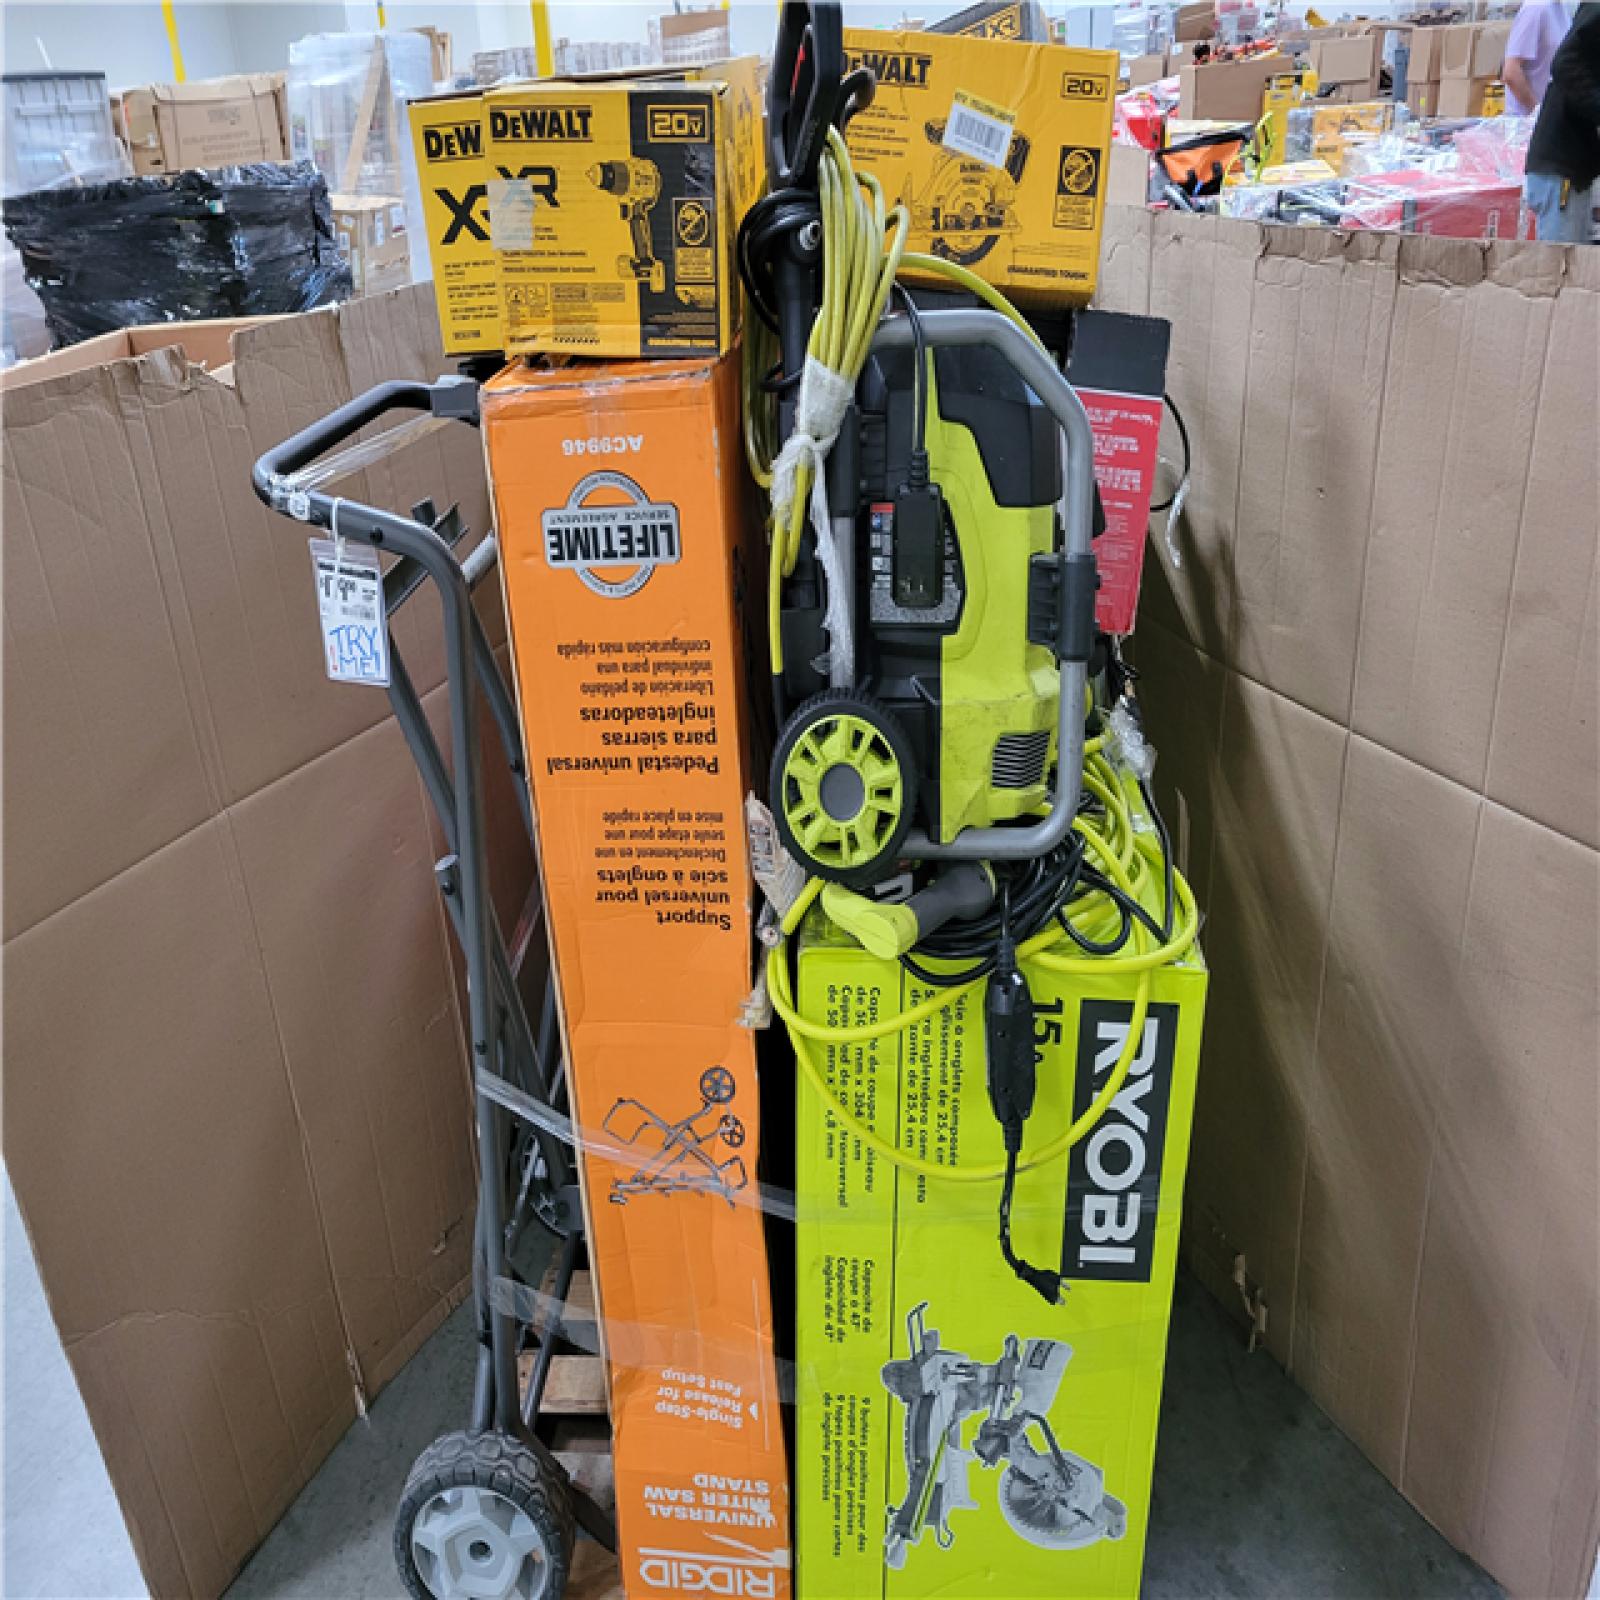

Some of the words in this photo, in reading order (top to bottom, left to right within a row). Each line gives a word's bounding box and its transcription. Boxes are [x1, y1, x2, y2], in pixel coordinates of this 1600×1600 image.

[841, 53, 931, 83] EWALT
[490, 110, 592, 138] DEWALT
[424, 124, 481, 158] DEW
[562, 434, 643, 457] AC9946
[547, 525, 676, 561] LIFETIME
[557, 640, 596, 660] rápida
[599, 642, 624, 658] más
[597, 662, 620, 673] una
[622, 658, 650, 673] para
[652, 660, 713, 676] individual
[580, 678, 629, 698] peldaño
[632, 682, 648, 696] de
[649, 680, 714, 698] Liberación
[580, 701, 715, 726] ingleteadoras
[602, 731, 668, 750] sierras
[673, 728, 718, 746] para
[547, 757, 632, 776] universal
[637, 755, 719, 776] Pedestal
[603, 808, 641, 825] rapide
[641, 808, 676, 825] place
[677, 812, 693, 823] en
[694, 812, 724, 826] mise
[604, 829, 626, 841] une
[629, 826, 656, 841] pour
[658, 827, 691, 844] étape
[692, 829, 726, 843] seule
[594, 847, 616, 858] une
[619, 847, 633, 858] en
[597, 865, 667, 886] onglets
[672, 869, 684, 886] à
[688, 869, 729, 888] scie
[595, 887, 638, 902] pour
[644, 890, 731, 908] universel
[656, 908, 731, 931] Support
[828, 984, 838, 1003] de
[856, 985, 867, 1005] de
[908, 989, 920, 1065] dezante
[827, 1045, 836, 1072] mm
[855, 1047, 864, 1074] mm
[868, 1055, 880, 1073] de
[840, 1069, 851, 1087] de
[907, 1069, 918, 1088] de
[865, 1078, 876, 1120] coupe
[938, 1089, 949, 1106] de
[905, 1093, 917, 1123] 25,4
[936, 1112, 948, 1142] 25,4
[827, 1132, 834, 1159] mm
[906, 1128, 915, 1148] cm
[1080, 1018, 1160, 1263] RYOBI
[853, 1139, 862, 1161] mm
[849, 1257, 860, 1296] coupe
[862, 1259, 875, 1313] Capacité
[836, 1256, 848, 1324] Capacidad
[824, 1303, 834, 1319] de
[836, 1327, 847, 1342] de
[862, 1317, 873, 1333] de
[662, 1369, 706, 1389] Setup
[709, 1378, 742, 1399] Fast
[656, 1386, 680, 1401] for
[684, 1389, 743, 1413] Release
[823, 1392, 833, 1408] de
[655, 1401, 743, 1430] Single-Step
[692, 1473, 770, 1495] STAND
[857, 1449, 870, 1501] positives
[642, 1484, 696, 1504] SAW
[644, 1502, 773, 1529] UNIVERSAL
[832, 1493, 842, 1521] para
[857, 1502, 866, 1531] pour
[857, 1533, 868, 1553] des
[639, 1559, 776, 1598] RIDGID
